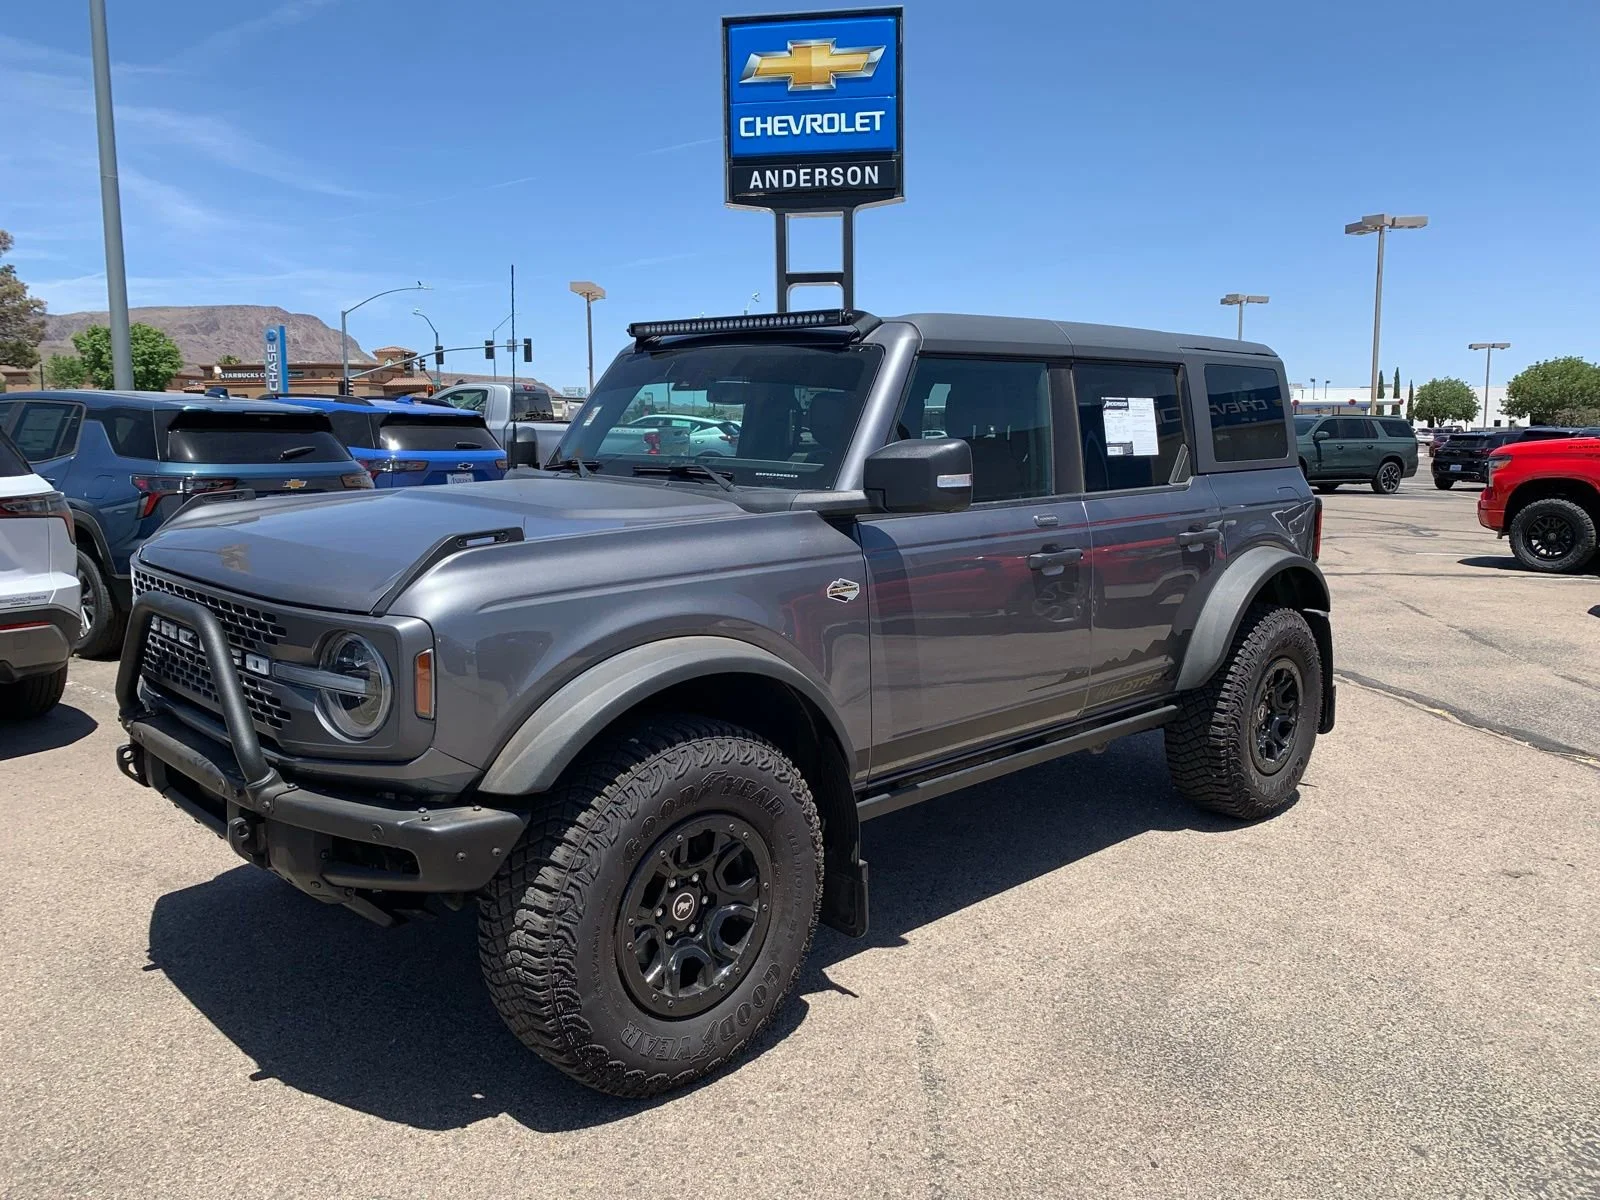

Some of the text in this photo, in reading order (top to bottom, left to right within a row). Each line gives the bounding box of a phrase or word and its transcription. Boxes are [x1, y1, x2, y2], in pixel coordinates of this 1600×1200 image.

[739, 111, 885, 137] CHEVROLET
[750, 166, 879, 189] ANDERSON
[267, 344, 278, 391] CHASE
[622, 770, 786, 863] GOODYEAR
[620, 962, 781, 1064] GOODYEAR
